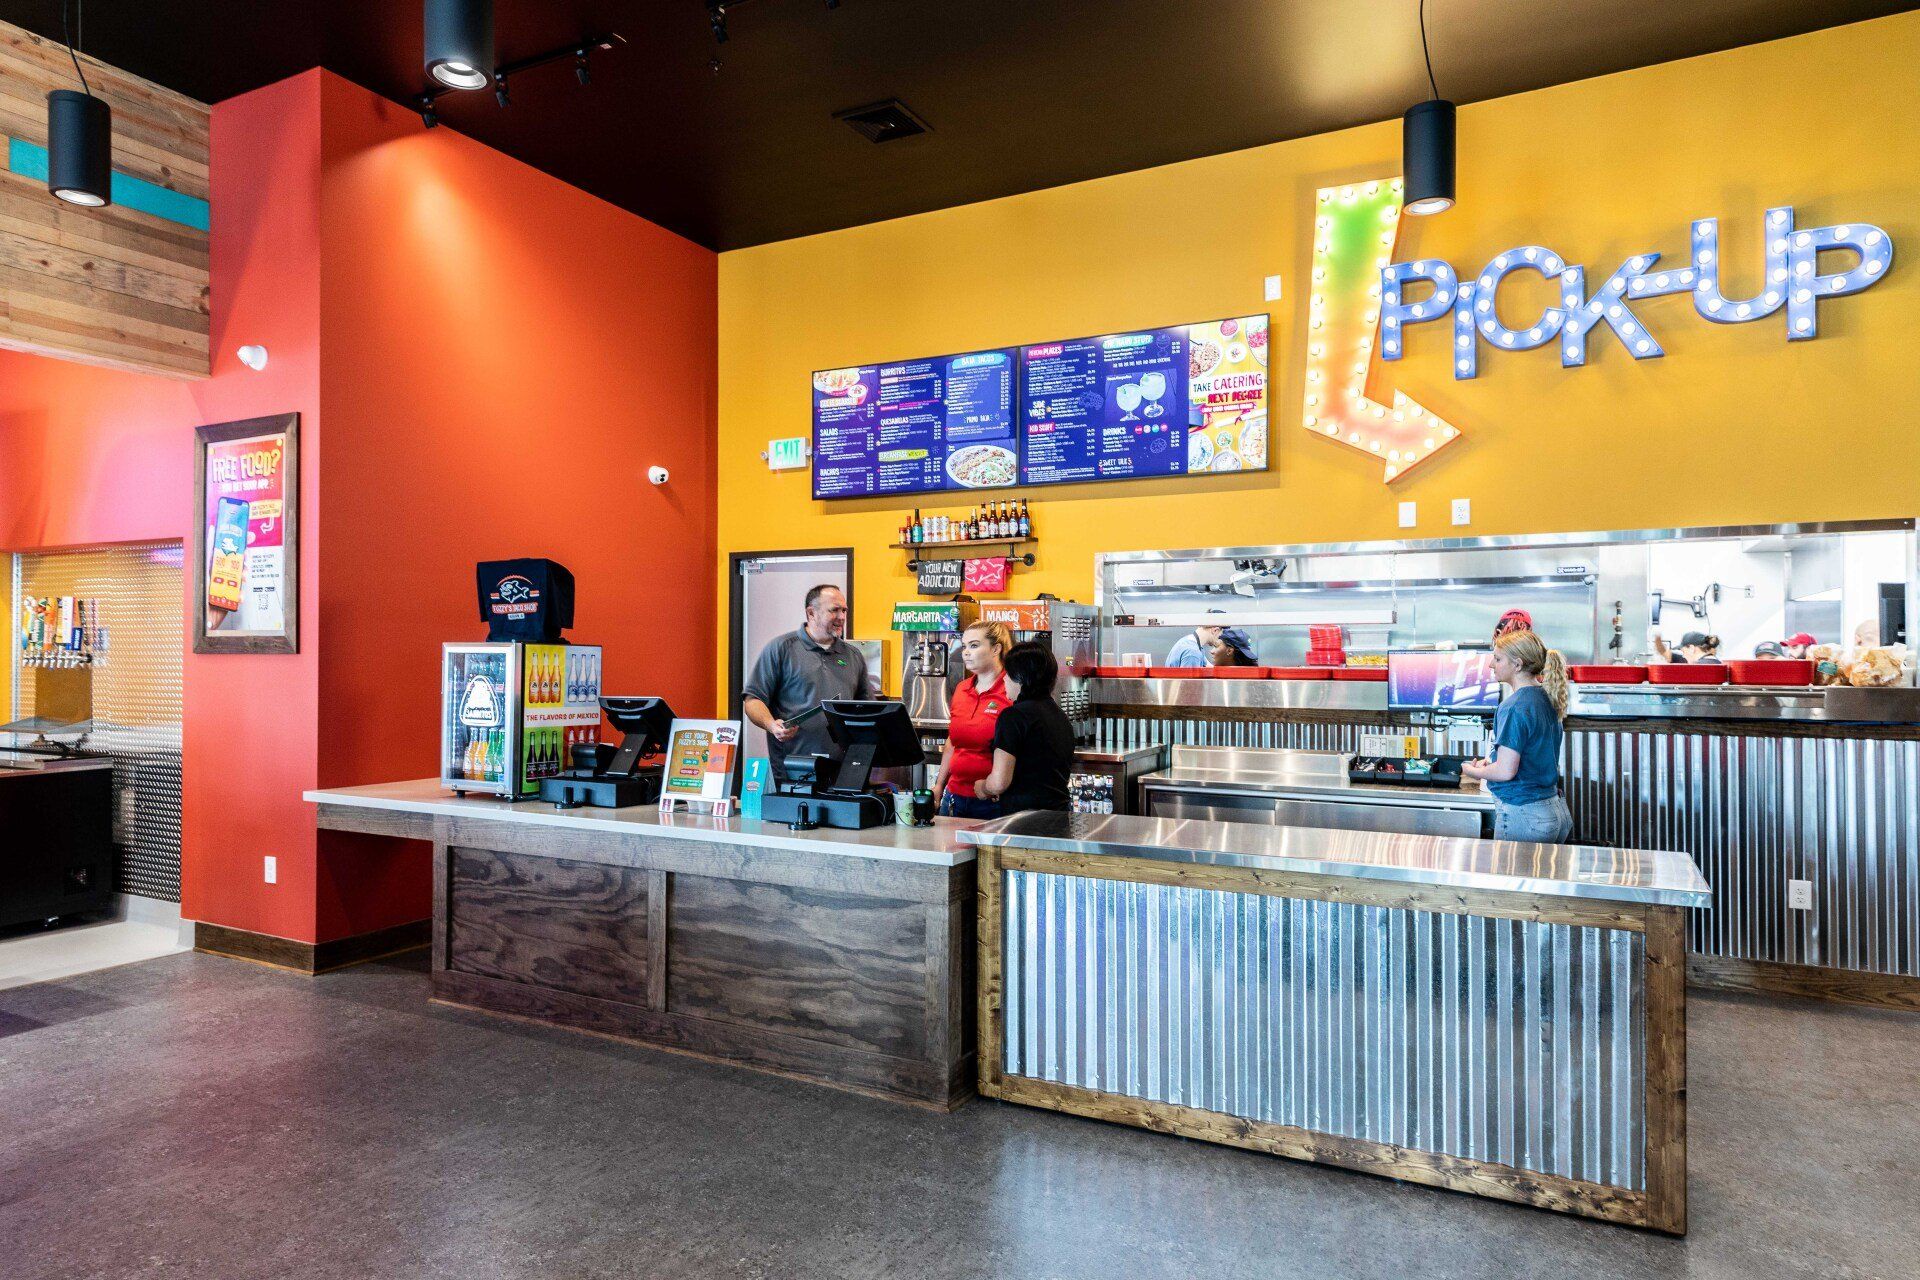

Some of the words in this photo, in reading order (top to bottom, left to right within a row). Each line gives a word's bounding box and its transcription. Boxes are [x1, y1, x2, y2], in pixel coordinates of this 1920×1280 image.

[1380, 206, 1893, 380] PICK-UP
[1194, 382, 1211, 392] TAKE
[1208, 392, 1230, 404] NEXT
[1232, 389, 1263, 402] DEGREE
[820, 428, 839, 437] SALADS
[775, 439, 800, 462] EXIT
[212, 455, 238, 483] FREE
[240, 448, 281, 480] FOOD?
[925, 562, 942, 574] YOUR
[942, 561, 958, 574] NEW
[918, 575, 961, 589] ADDICTION
[893, 611, 941, 622] MARGARITA
[986, 610, 1019, 622] MANGO
[539, 713, 567, 721] FLAVORS
[751, 760, 760, 778] 1
